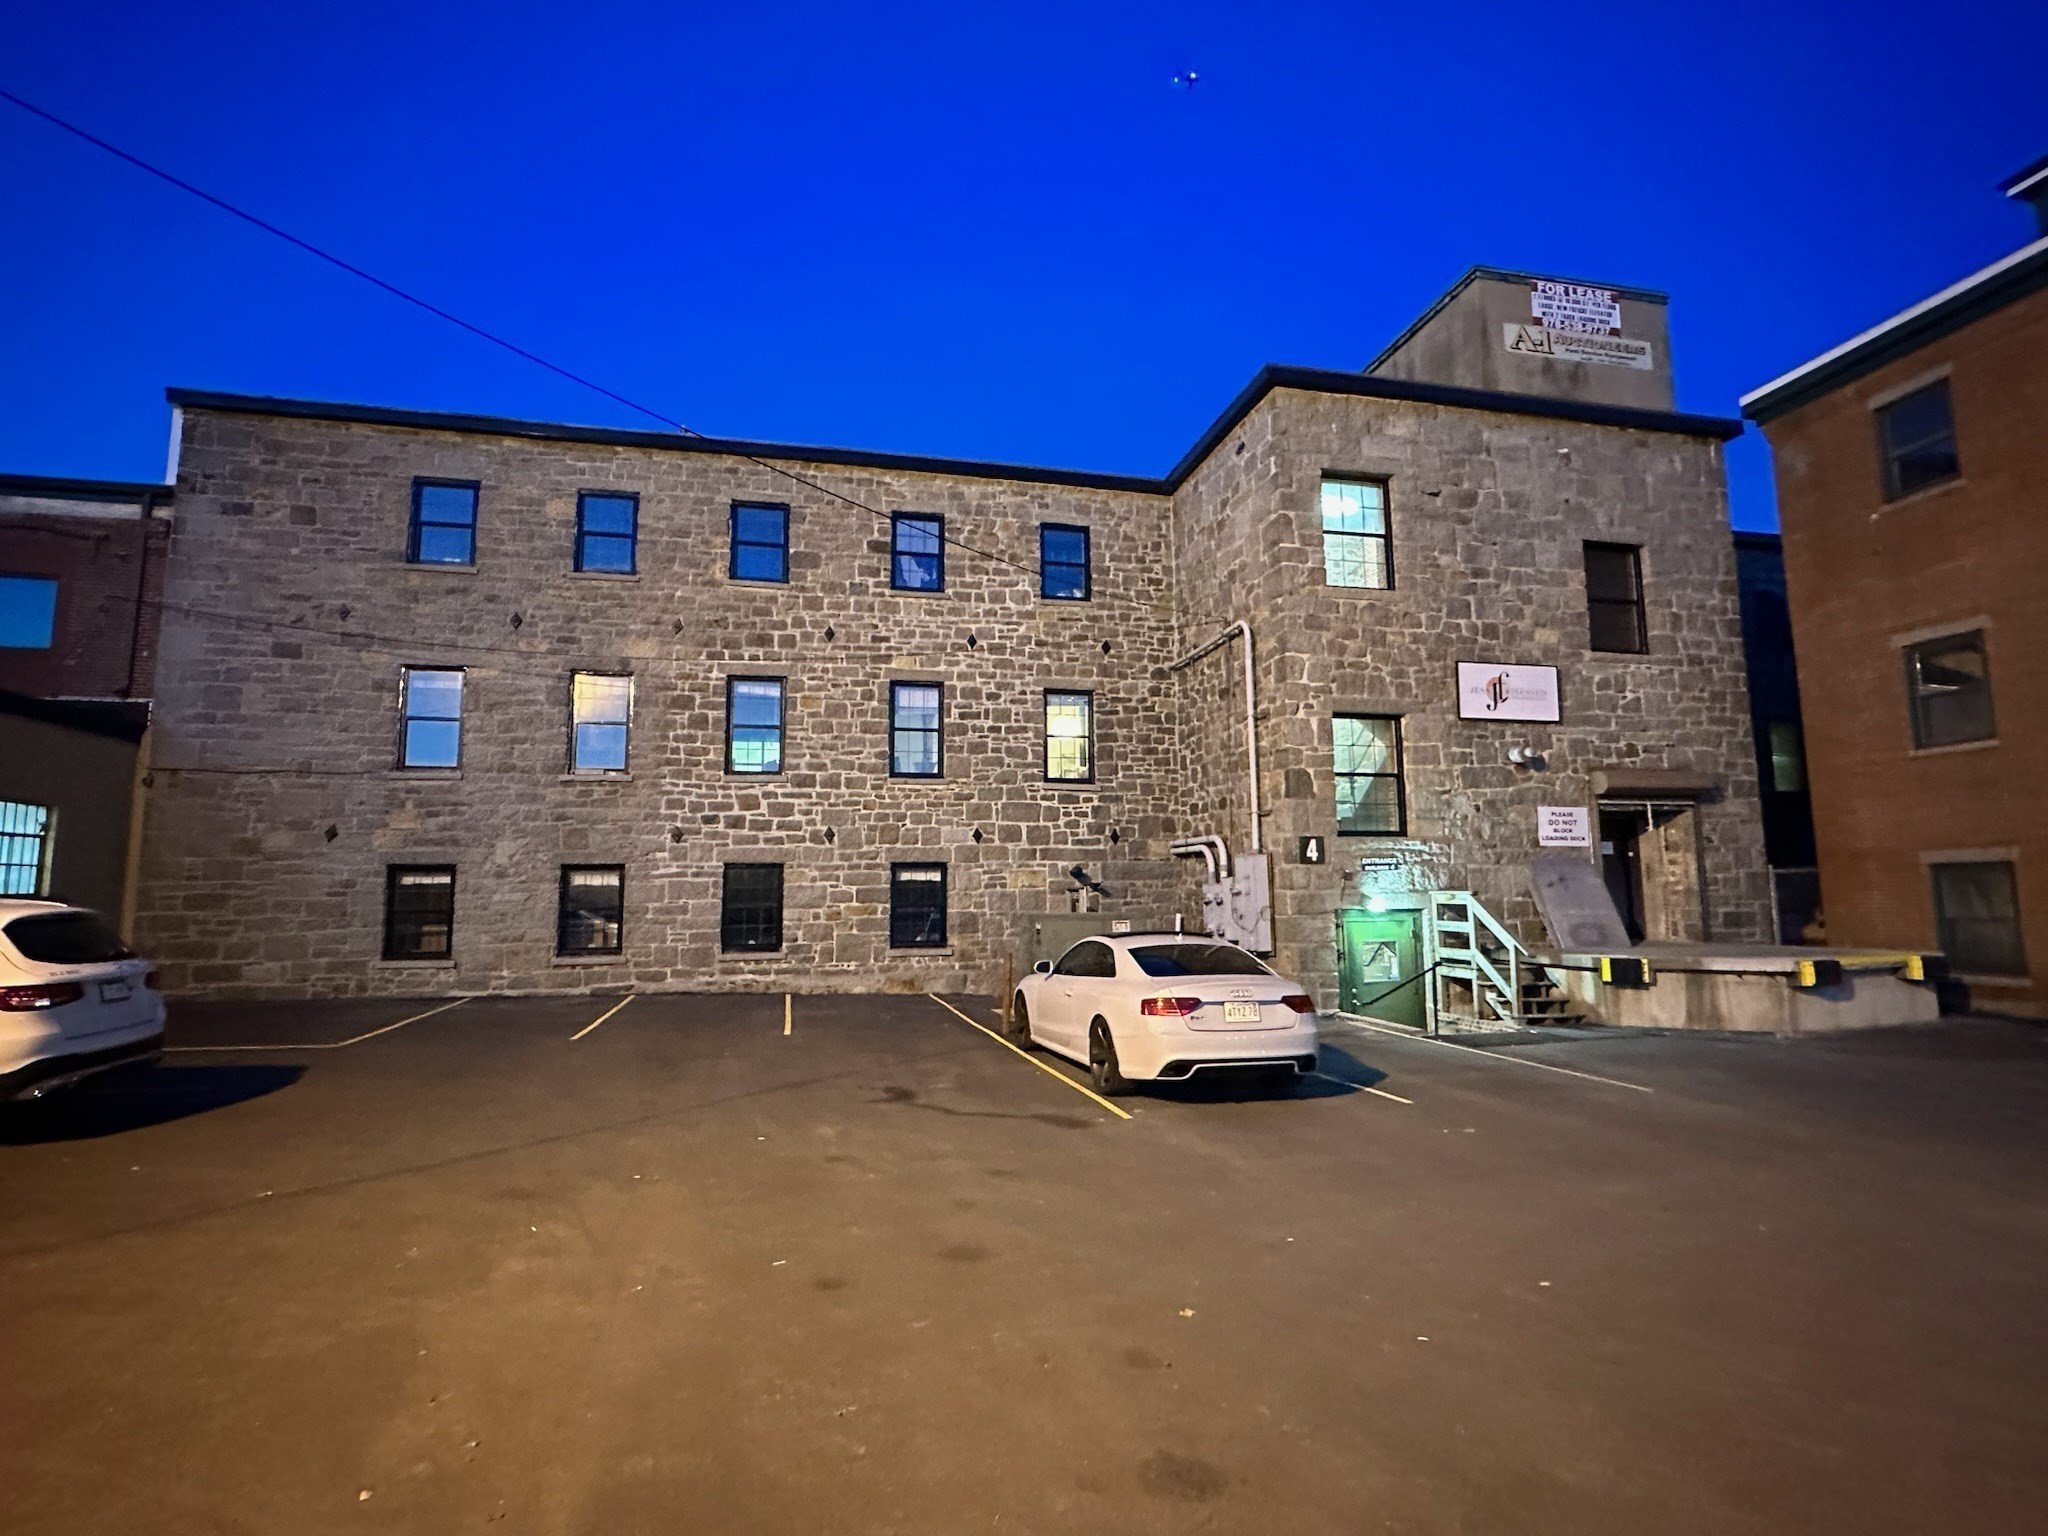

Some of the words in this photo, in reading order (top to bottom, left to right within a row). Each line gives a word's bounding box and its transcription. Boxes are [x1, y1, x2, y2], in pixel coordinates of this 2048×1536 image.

[1537, 282, 1565, 296] FOR
[1569, 287, 1612, 303] LEASE
[1305, 838, 1319, 862] 4
